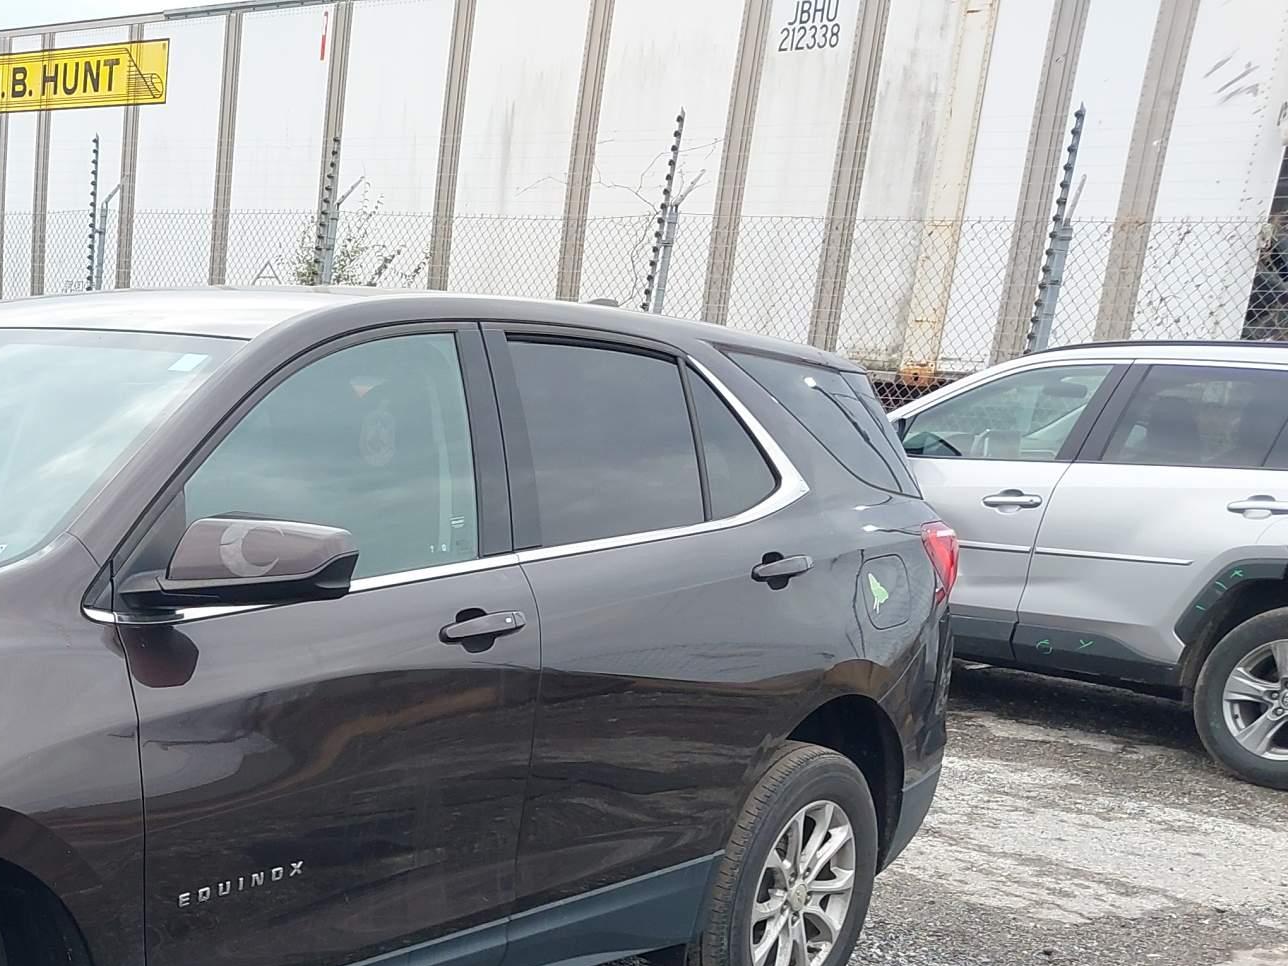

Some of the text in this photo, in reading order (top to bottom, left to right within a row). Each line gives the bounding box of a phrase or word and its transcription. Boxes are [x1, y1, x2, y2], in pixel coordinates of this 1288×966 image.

[788, 0, 840, 25] JBHU
[778, 23, 841, 52] 212338
[41, 58, 121, 97] HUNT
[178, 860, 304, 908] EQUINOX
